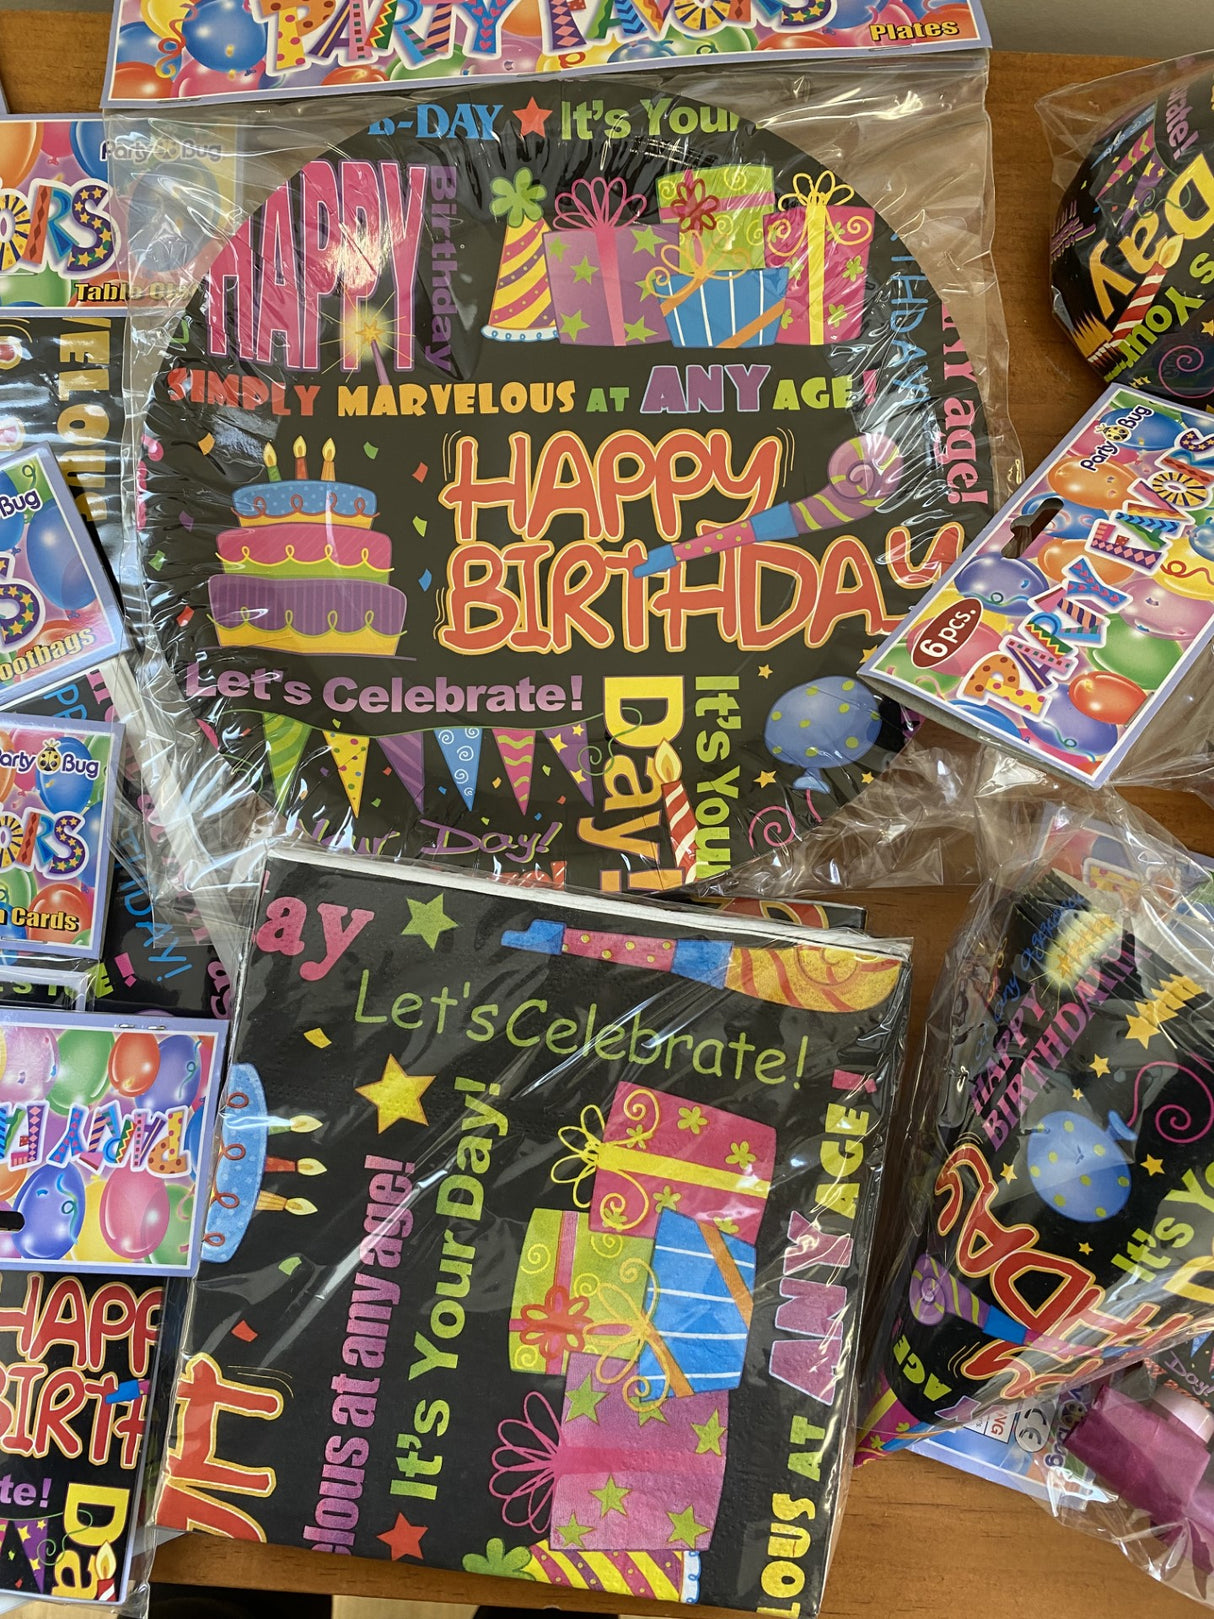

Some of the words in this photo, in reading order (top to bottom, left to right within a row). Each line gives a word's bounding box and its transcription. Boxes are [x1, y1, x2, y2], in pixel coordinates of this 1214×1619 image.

[250, 0, 513, 70] PARTY
[869, 19, 959, 41] Plates
[561, 99, 632, 140] It's
[202, 158, 430, 372] HAPPY
[425, 165, 459, 372] Birthday
[167, 367, 321, 418] SIMPLY
[337, 379, 576, 417] MARVELOUS
[586, 387, 630, 412] AT
[640, 364, 772, 414] ANY
[1080, 440, 1118, 472] Party
[1117, 405, 1153, 429] Bug
[438, 428, 781, 542] HAPPY
[932, 397, 989, 505] age!
[438, 520, 966, 656] BIRTHDAY
[920, 637, 948, 658] 6
[946, 608, 977, 645] pcs.
[960, 558, 1132, 717] PARTY
[185, 662, 312, 714] Let's
[322, 674, 584, 716] Celebrate!
[695, 676, 742, 763] It's
[62, 754, 99, 778] Bug
[576, 675, 686, 893] Day!
[419, 820, 563, 864] Day!
[11, 906, 80, 932] Cards
[355, 969, 499, 1042] Let's
[505, 997, 809, 1091] Celebrate!
[969, 982, 1046, 1117] HAPPY
[48, 1103, 189, 1178] PARTY
[436, 1076, 509, 1221] Day!
[811, 1068, 878, 1220] AGE!
[359, 1154, 416, 1270] age!
[1111, 1217, 1195, 1283] It's
[341, 1272, 401, 1369] any
[408, 1230, 477, 1382] Your
[768, 1210, 854, 1407] ANY
[330, 1372, 381, 1428] at
[786, 1415, 826, 1482] AT
[389, 1397, 451, 1501] It's
